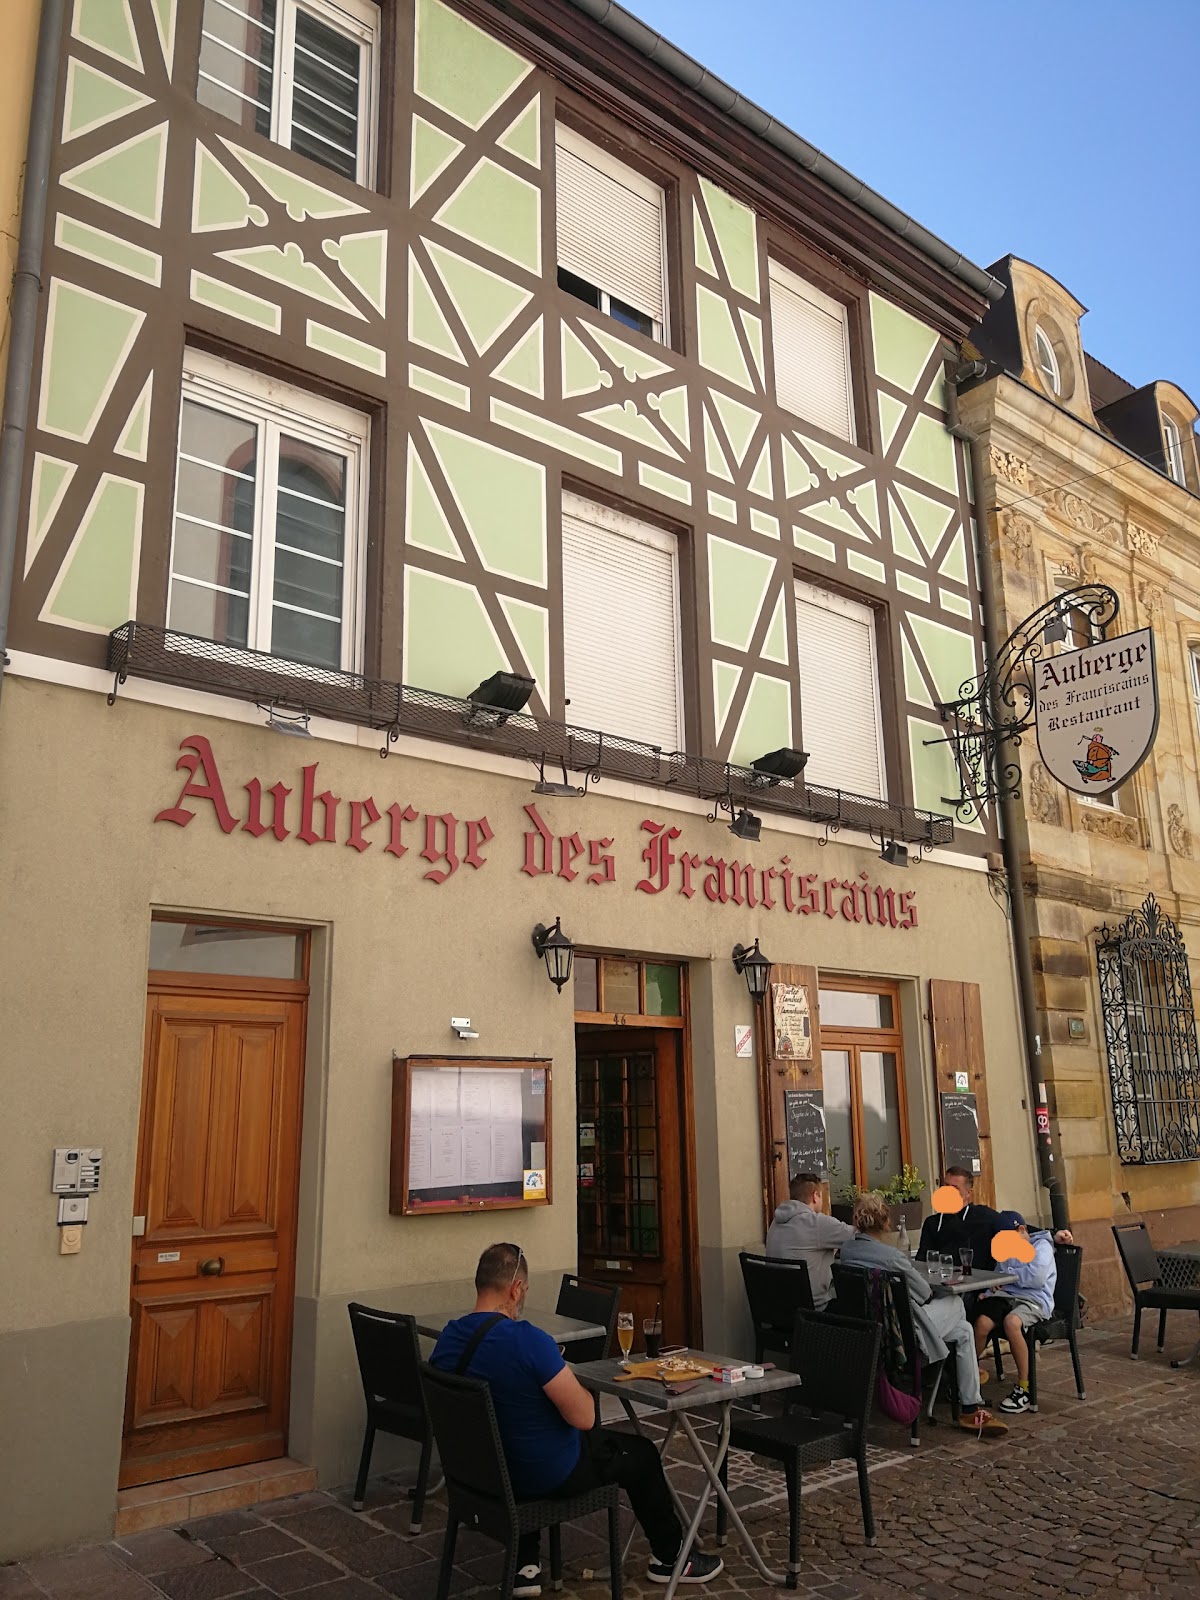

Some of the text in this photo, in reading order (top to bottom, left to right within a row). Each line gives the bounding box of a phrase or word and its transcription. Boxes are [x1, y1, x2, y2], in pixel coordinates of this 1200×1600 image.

[1039, 643, 1148, 692] Auberge
[1039, 673, 1150, 713] des Franciscains
[1048, 696, 1141, 732] Restaurant
[154, 735, 919, 929] Auberge des Franciscains
